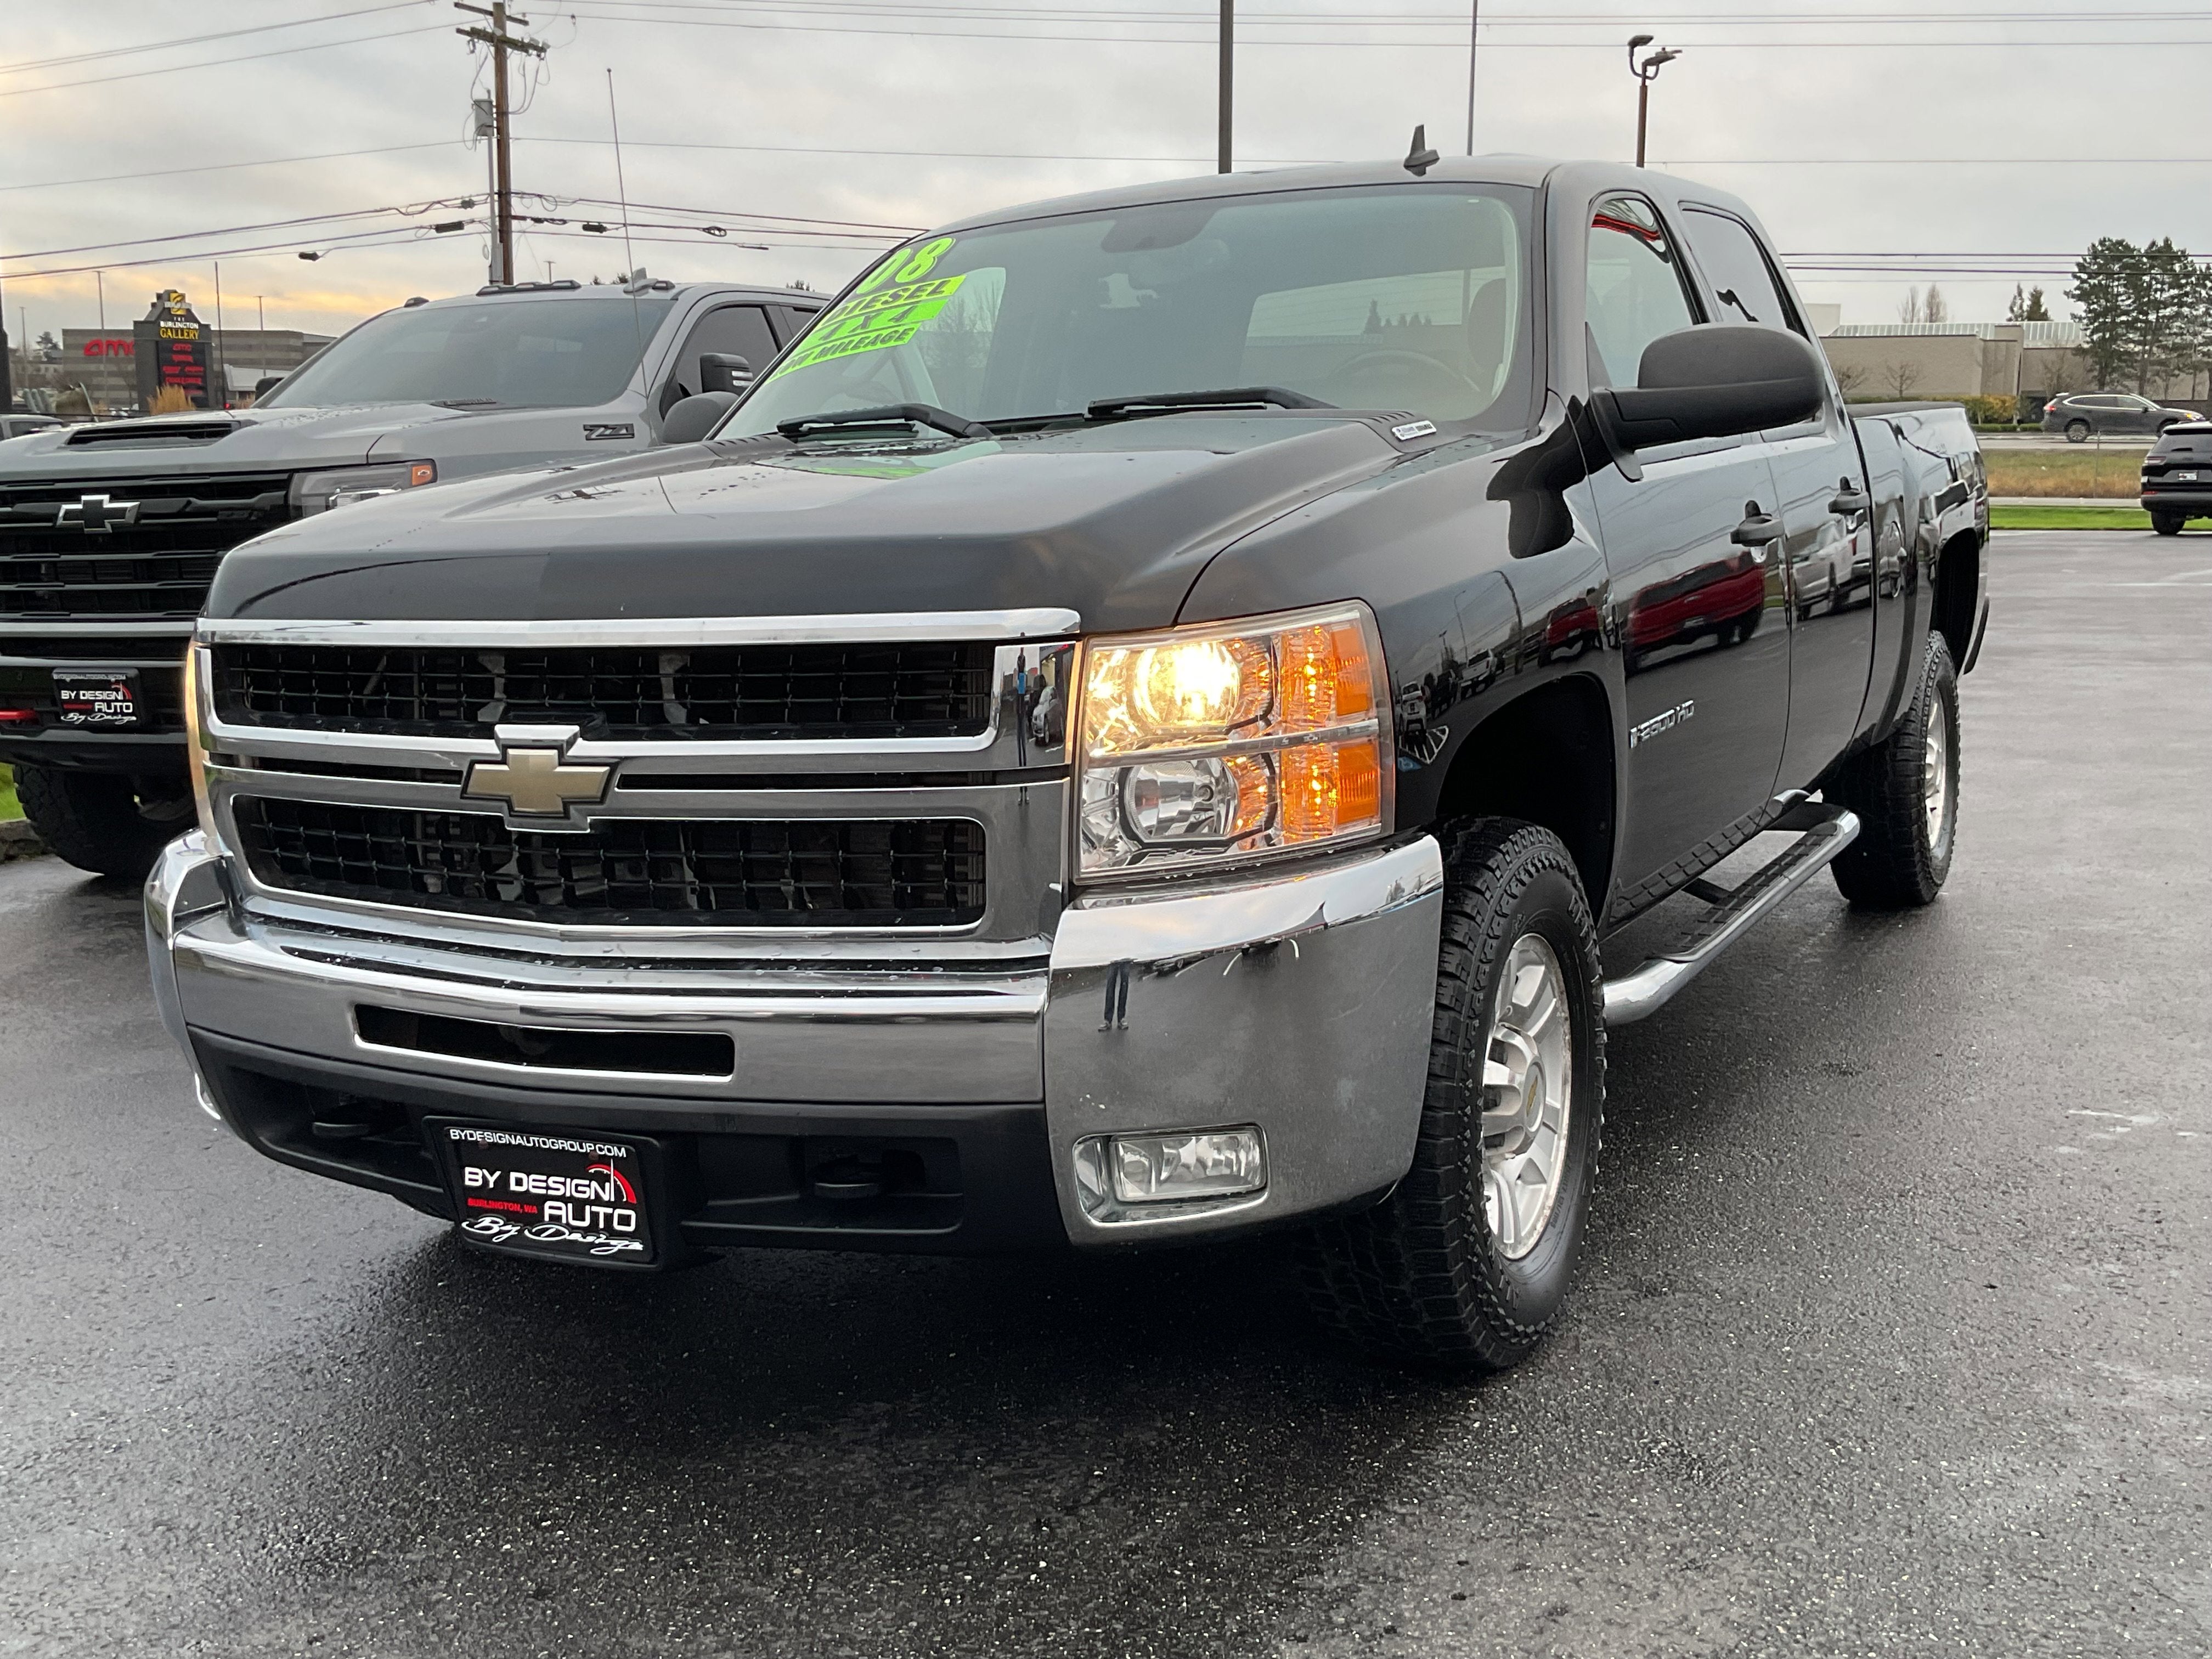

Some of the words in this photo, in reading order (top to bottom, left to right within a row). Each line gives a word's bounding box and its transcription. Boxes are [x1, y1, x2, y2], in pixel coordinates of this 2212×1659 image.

[822, 279, 951, 325] DIESEL
[160, 320, 199, 329] BURLINGTON
[160, 328, 199, 339] GALLERY
[812, 327, 916, 360] MILEAGE
[583, 423, 635, 441] Z71
[61, 690, 77, 699] BY
[80, 691, 122, 699] DESIGN
[94, 702, 133, 713] AUTO
[450, 1128, 627, 1158] BYDESIGNAUTOGROUPCOM
[464, 1166, 501, 1188] BY
[510, 1171, 610, 1201] DESIGN
[523, 1204, 538, 1214] WA
[544, 1200, 636, 1232] AUTO
[461, 1216, 521, 1243] By
